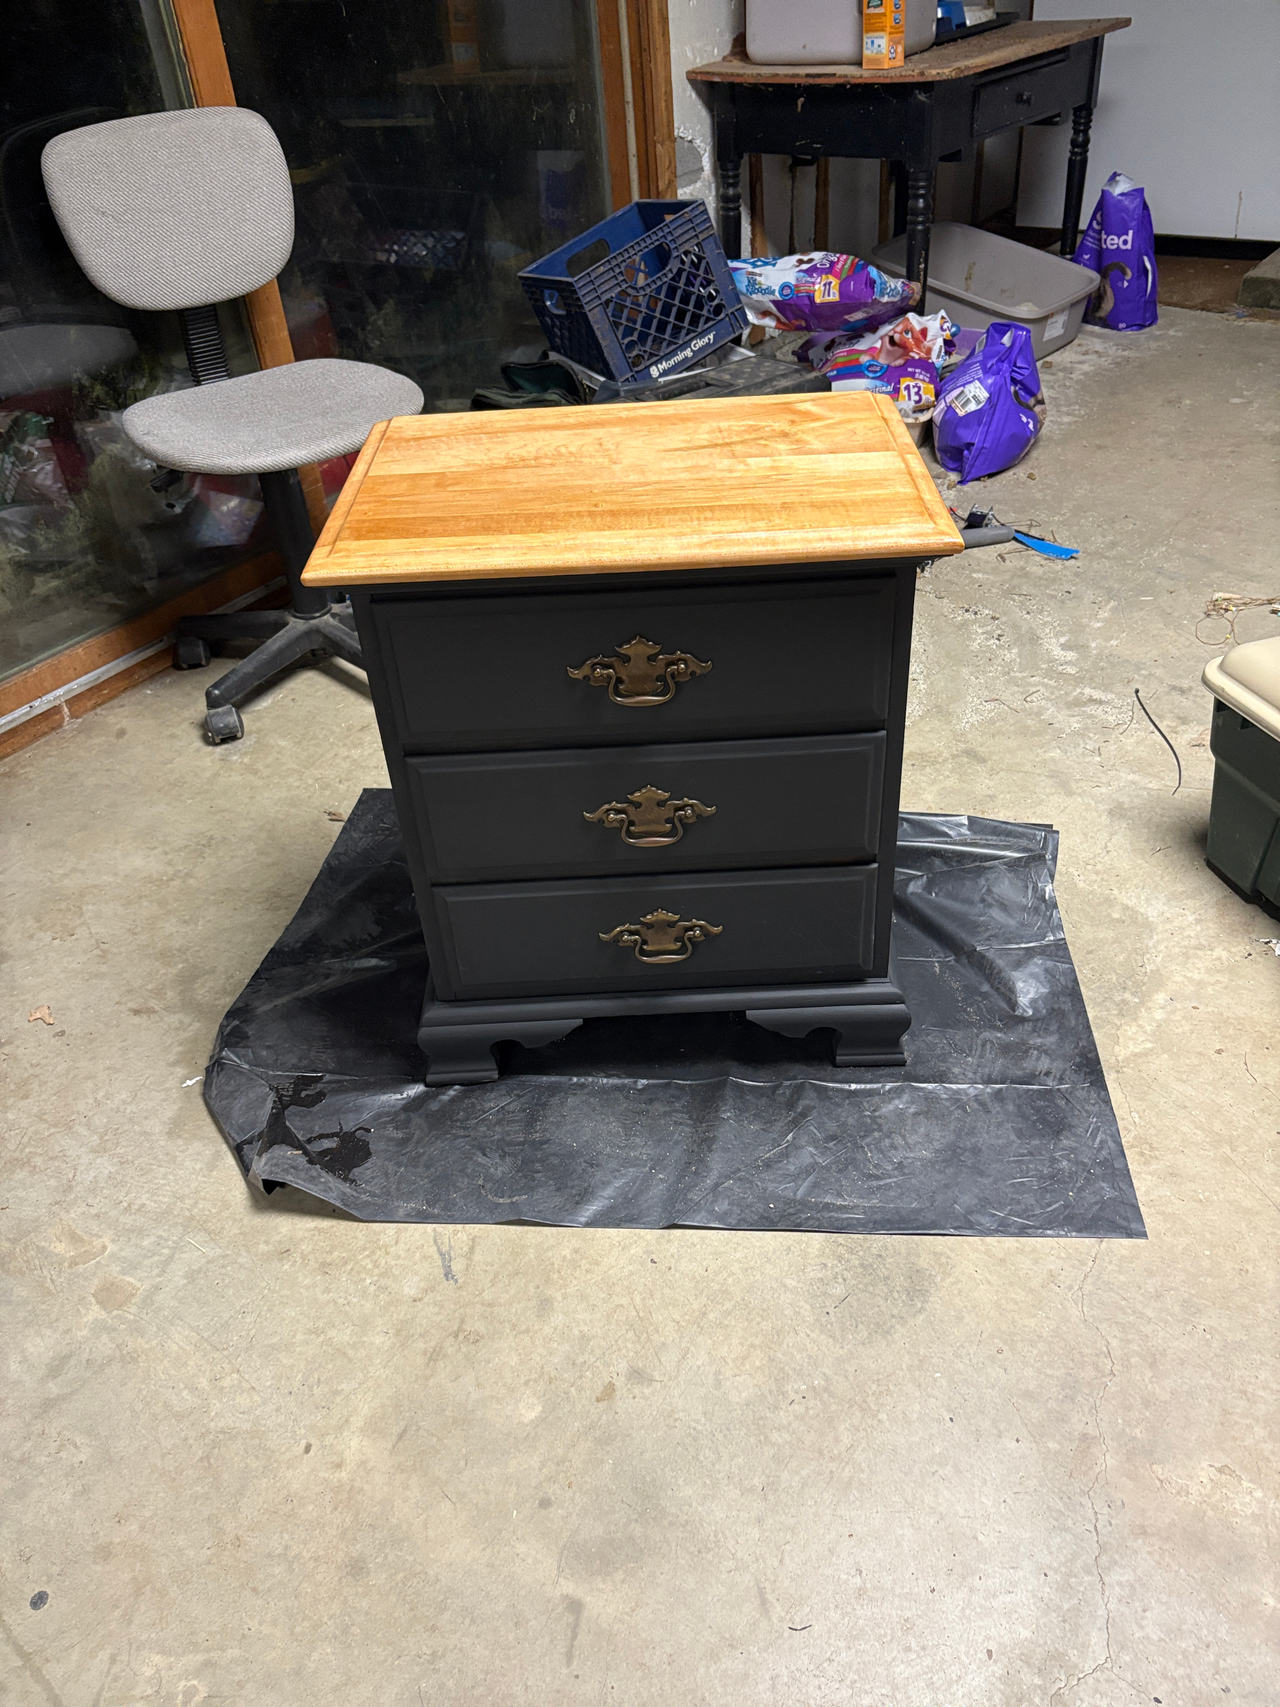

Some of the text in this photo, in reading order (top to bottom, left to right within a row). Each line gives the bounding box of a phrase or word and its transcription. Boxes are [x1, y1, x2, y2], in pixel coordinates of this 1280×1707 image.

[1101, 229, 1133, 250] ted
[821, 280, 833, 299] 11
[657, 331, 715, 374] Morning Glory
[903, 383, 923, 404] 13
